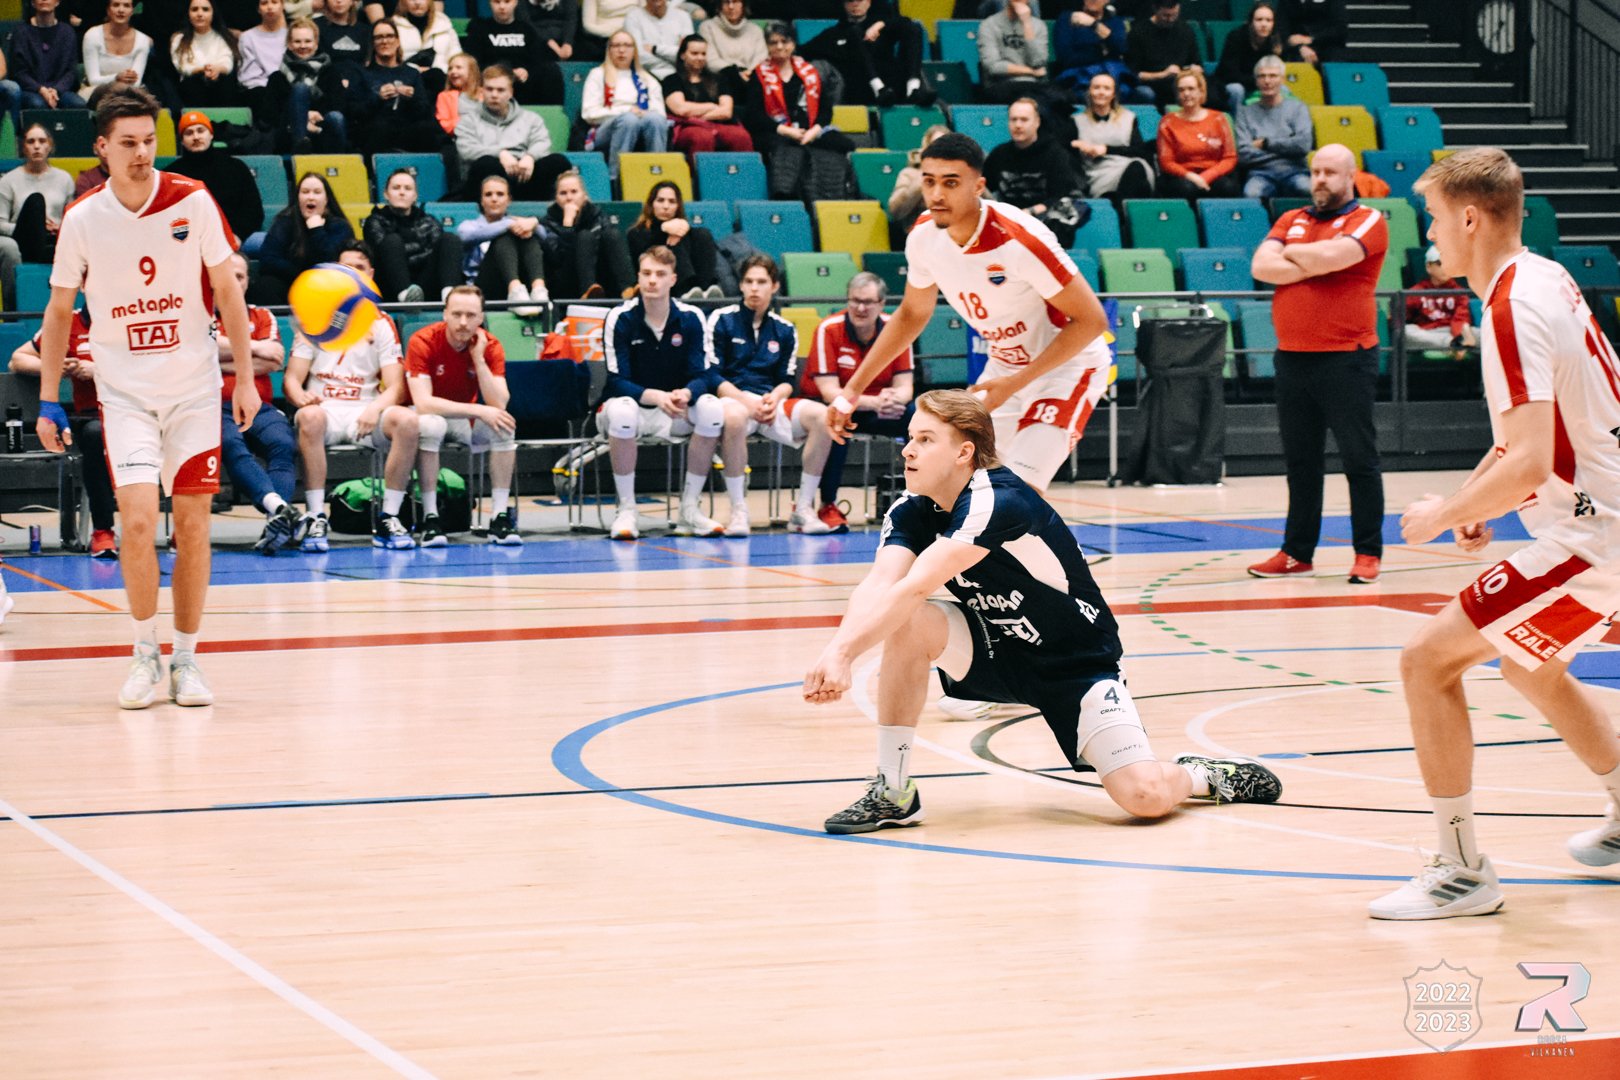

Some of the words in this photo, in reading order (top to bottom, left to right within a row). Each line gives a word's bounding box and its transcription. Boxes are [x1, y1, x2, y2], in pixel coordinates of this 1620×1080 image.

[488, 33, 526, 47] VANS
[138, 256, 157, 286] 9
[958, 292, 988, 320] 18
[1033, 402, 1059, 424] 18
[207, 456, 218, 476] 9
[1480, 564, 1509, 595] 10
[1508, 625, 1559, 660] RALE
[1104, 687, 1120, 704] 4
[1100, 707, 1121, 715] CRAFT
